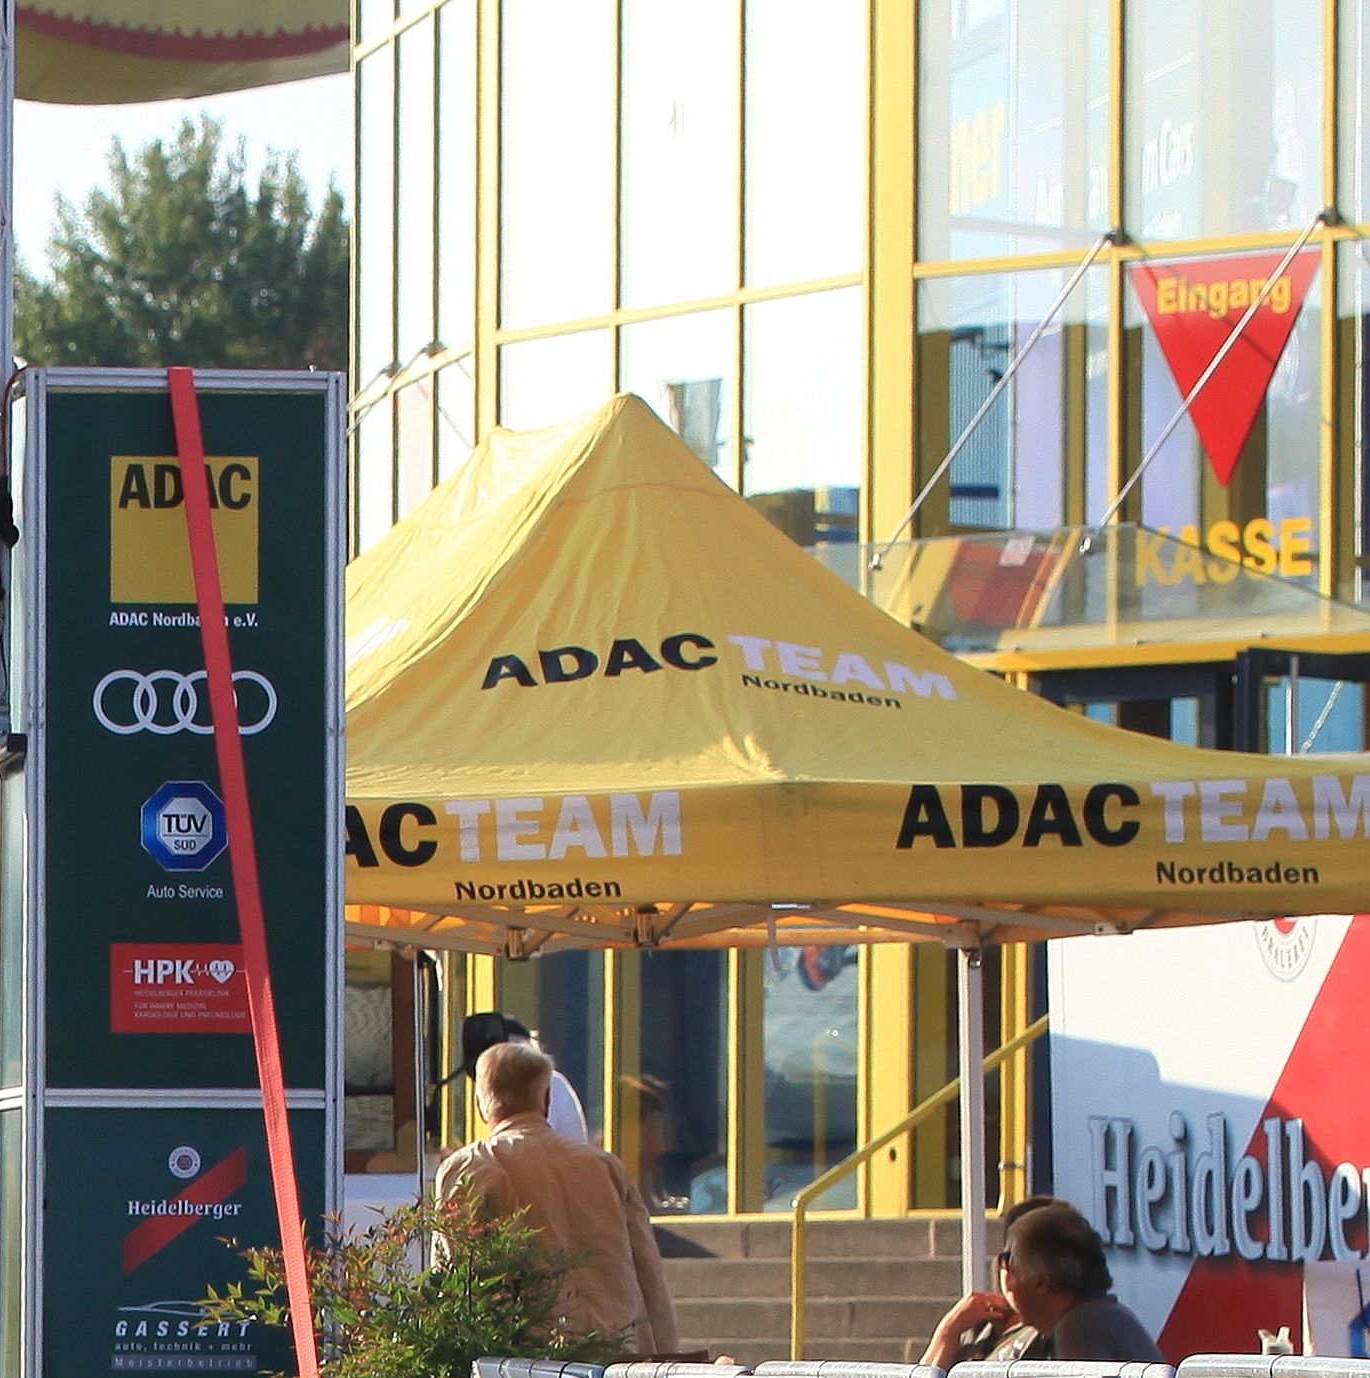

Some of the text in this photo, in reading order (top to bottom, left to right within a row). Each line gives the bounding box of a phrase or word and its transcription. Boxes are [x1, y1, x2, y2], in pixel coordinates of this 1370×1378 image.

[1157, 275, 1294, 319] Eingang
[1136, 517, 1313, 590] KASSE
[110, 612, 258, 627] ADAC Nordban e.V.
[480, 632, 961, 701] ADAC TEAM
[741, 673, 903, 710] Nordbaden
[162, 814, 208, 833] TÜV
[895, 773, 1370, 851] ADAC TEAM
[444, 790, 683, 863] TEAM
[173, 838, 197, 851] SÜD
[1156, 860, 1320, 886] Nordbaden
[147, 884, 224, 899] Auto Service
[453, 878, 622, 902] Nordbaden
[132, 959, 196, 985] HPK
[1087, 1110, 1370, 1262] Heidelbe
[128, 1200, 242, 1220] Heidelberger
[115, 1320, 251, 1337] GASSERT
